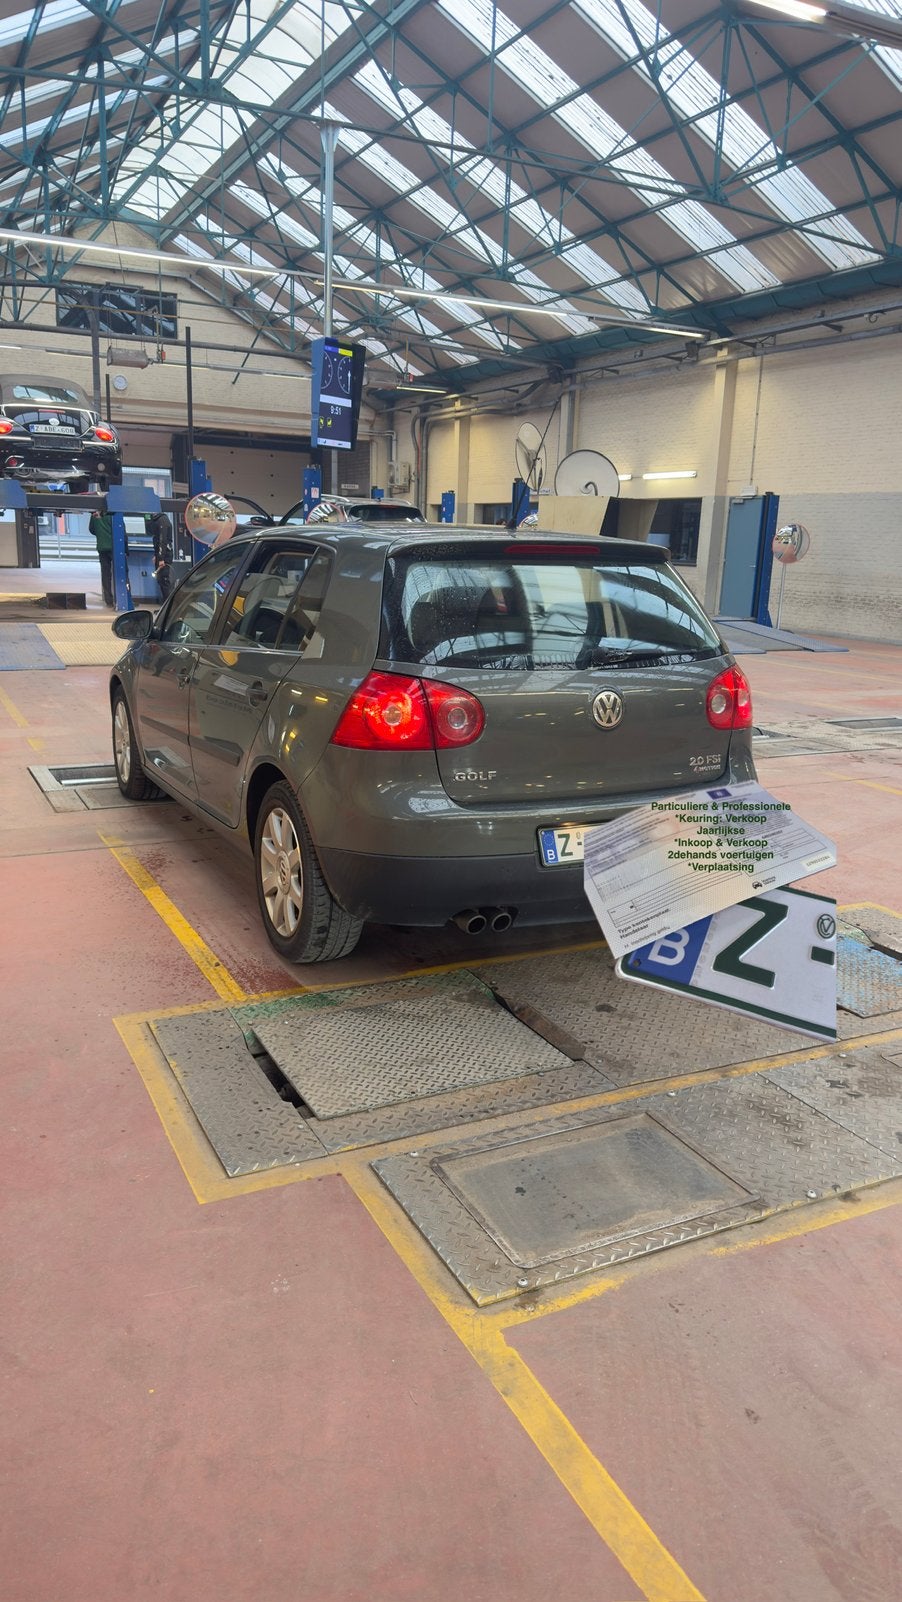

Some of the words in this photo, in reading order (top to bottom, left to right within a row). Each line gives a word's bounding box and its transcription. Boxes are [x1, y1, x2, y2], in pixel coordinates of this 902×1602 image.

[455, 770, 497, 781] GOLF
[547, 850, 555, 860] B
[648, 928, 690, 966] B
